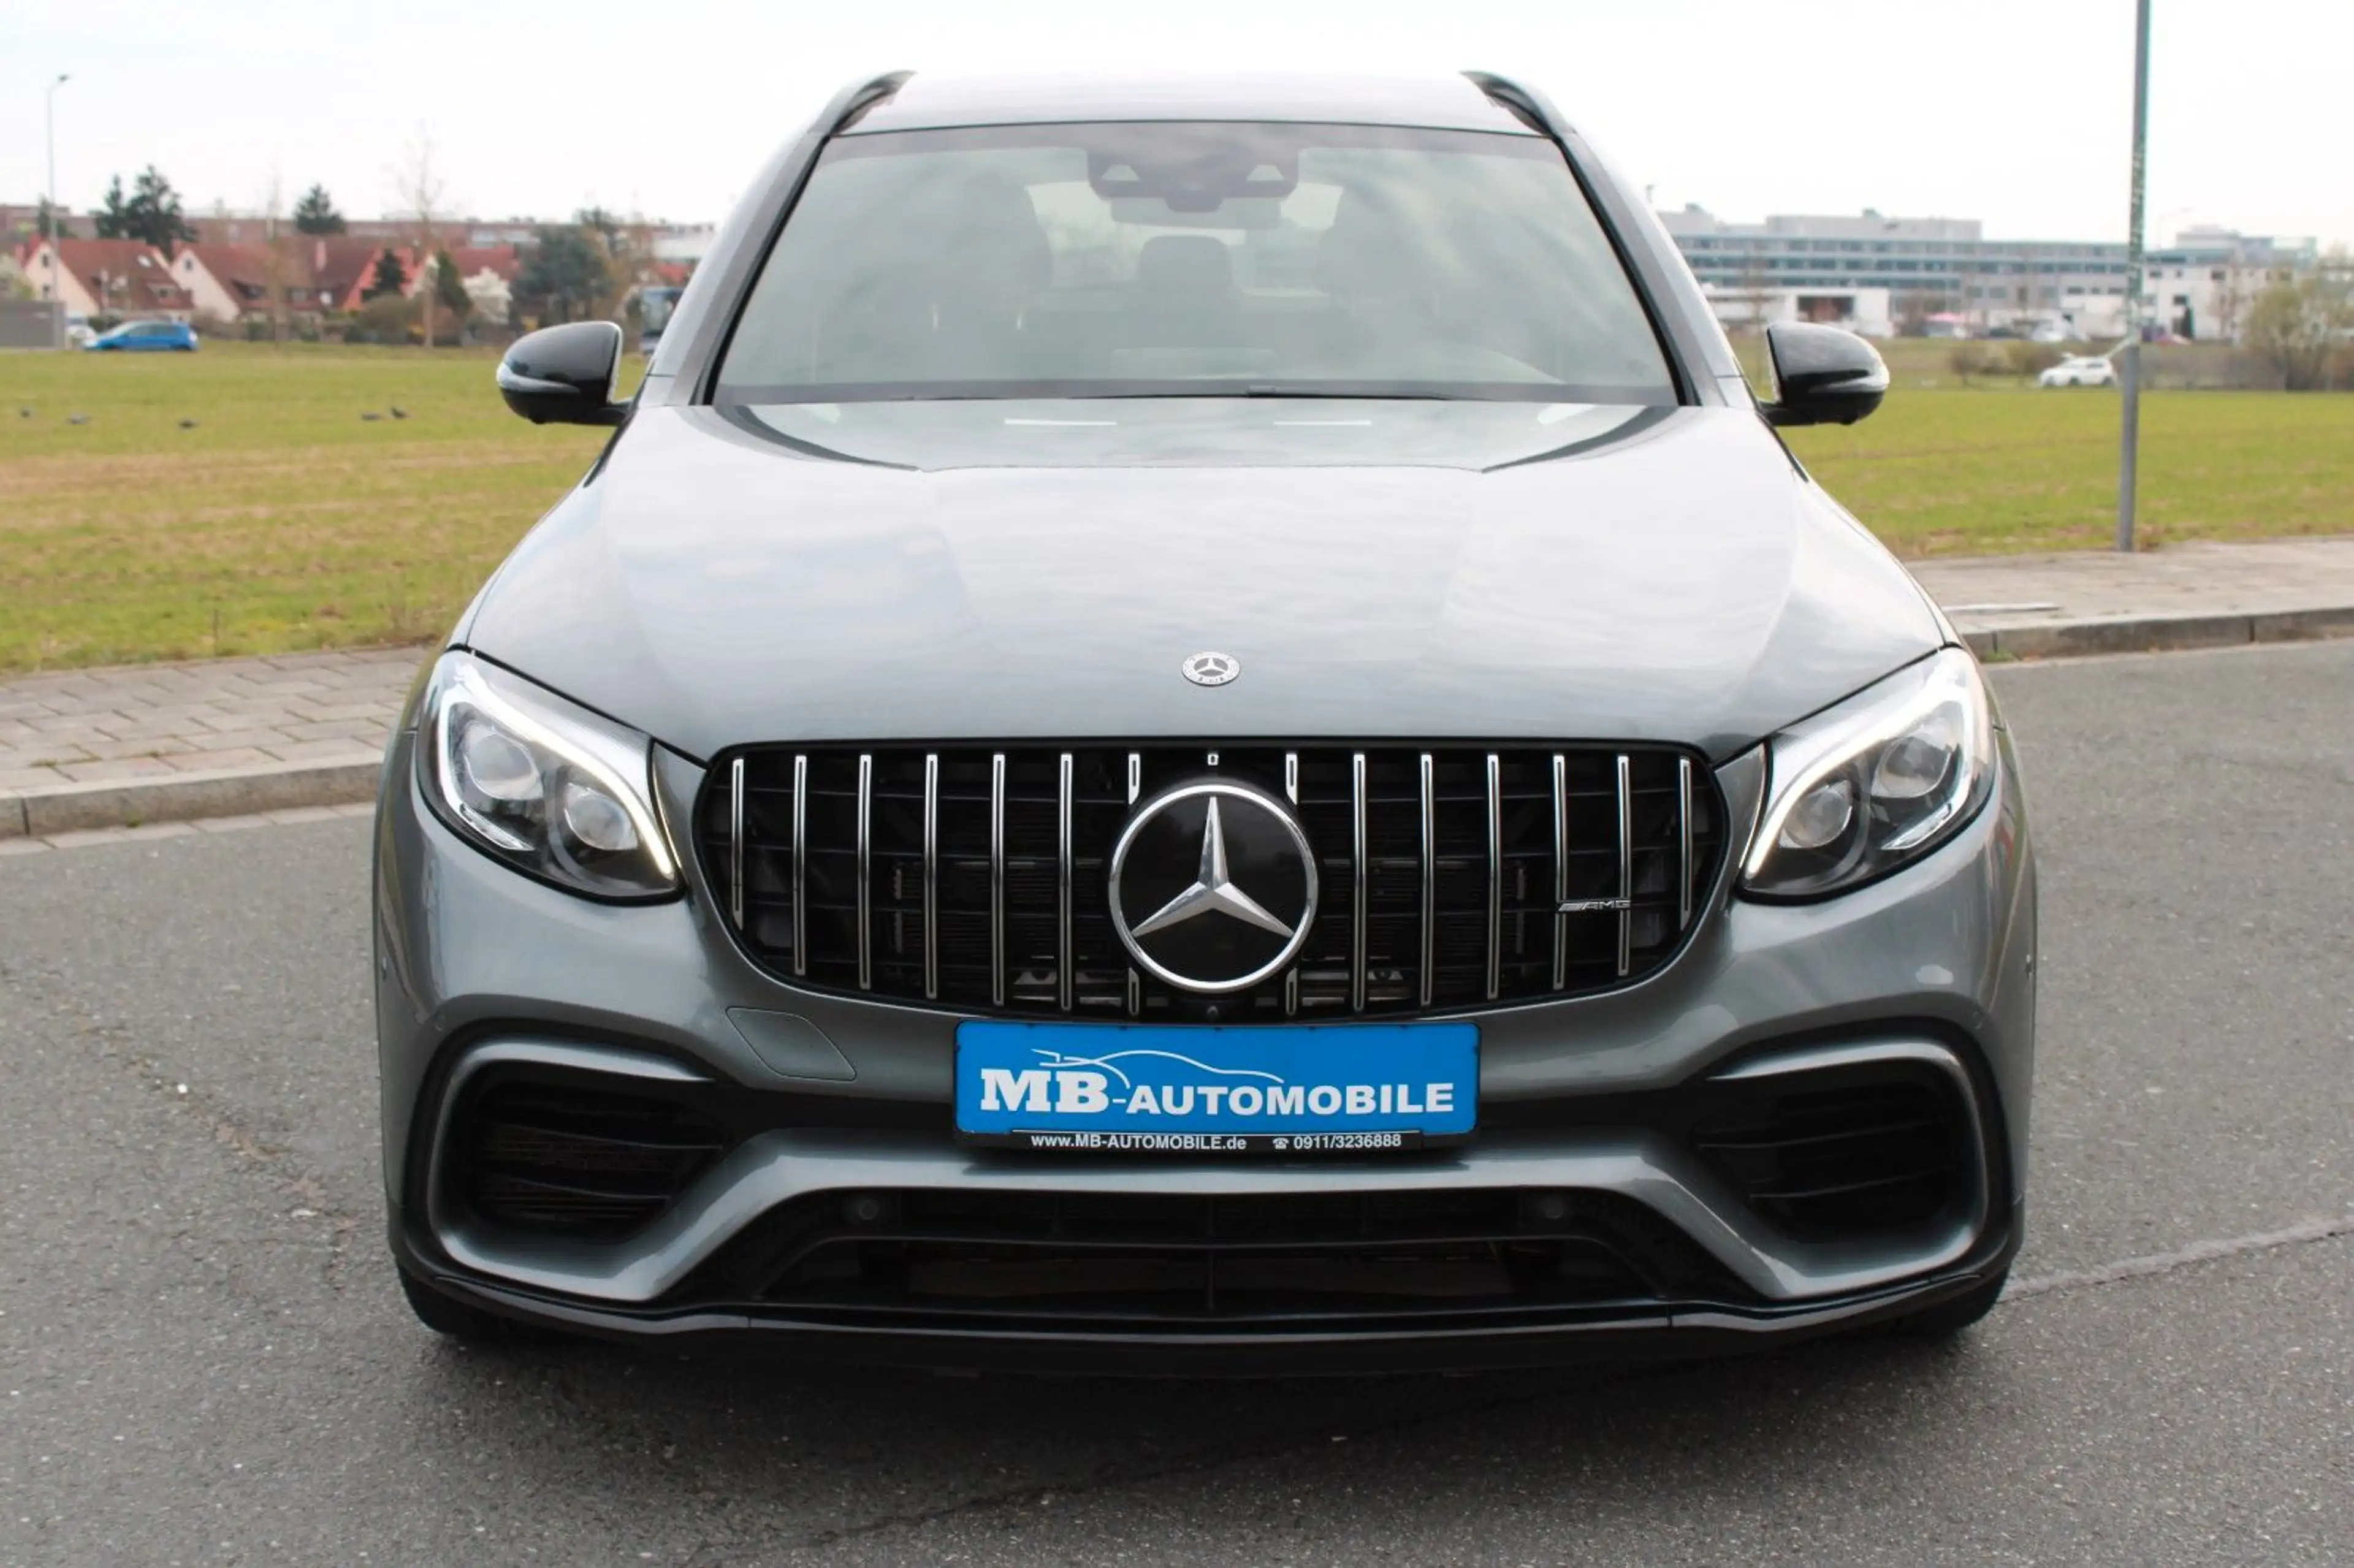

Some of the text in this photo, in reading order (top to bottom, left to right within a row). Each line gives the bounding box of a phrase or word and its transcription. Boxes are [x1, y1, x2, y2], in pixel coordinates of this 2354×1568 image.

[1580, 900, 1631, 911] AMG
[981, 1068, 1453, 1116] MB-AUTOMOBILE
[1031, 1134, 1401, 1150] www.MB-AUTOMOBILE.de 0911/3236888
